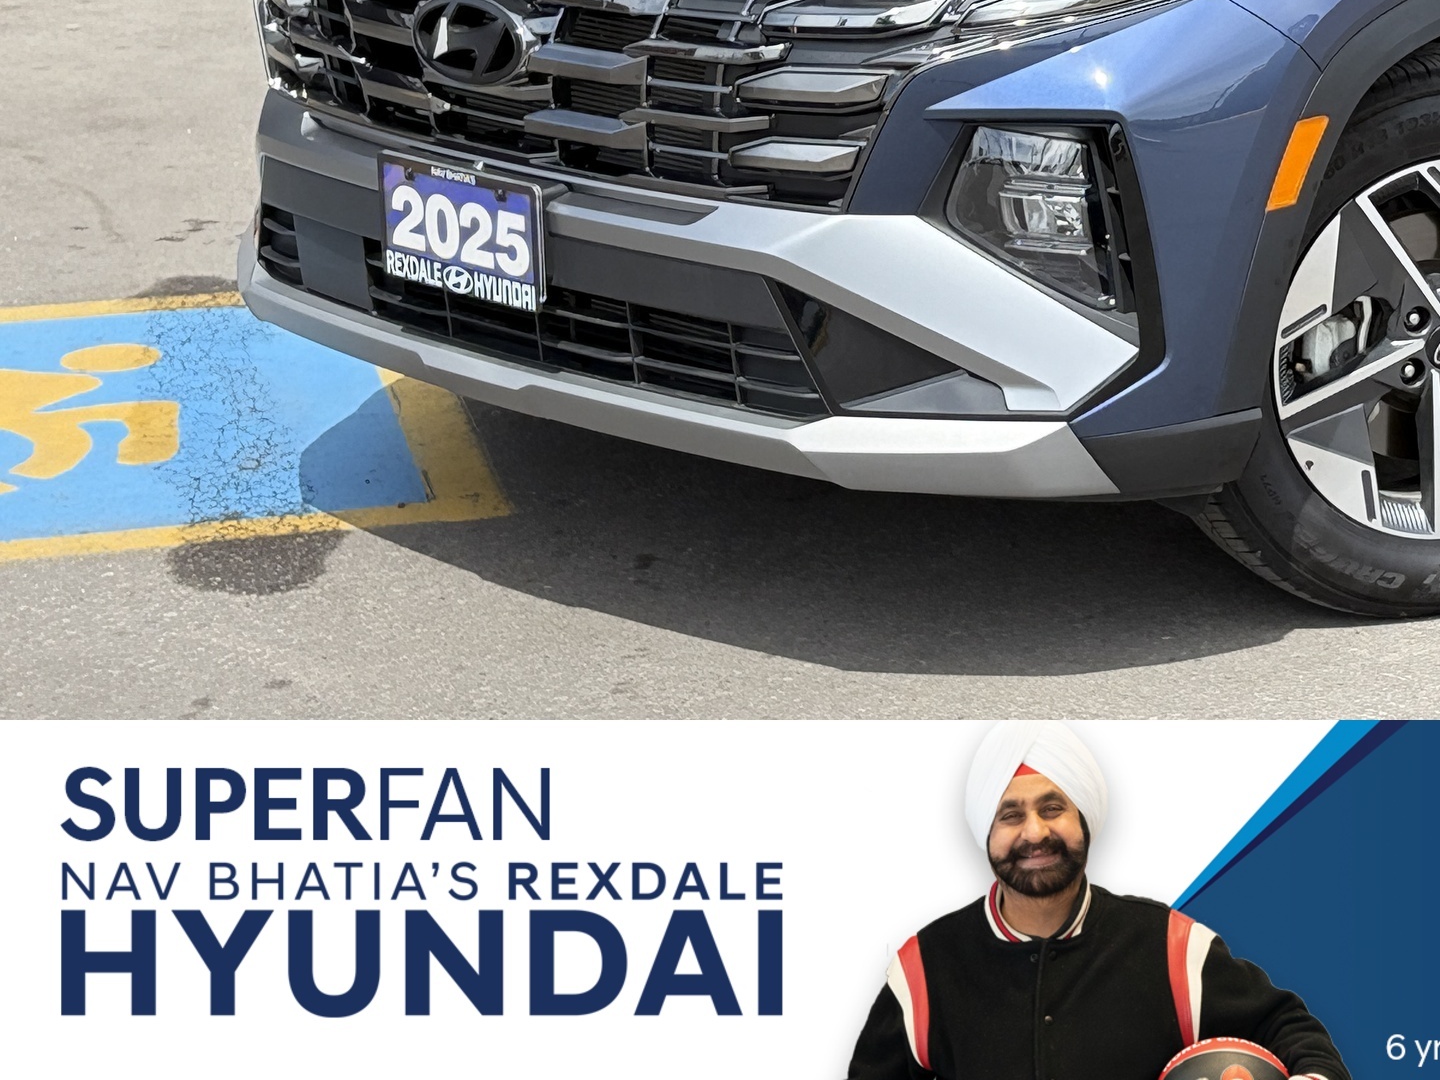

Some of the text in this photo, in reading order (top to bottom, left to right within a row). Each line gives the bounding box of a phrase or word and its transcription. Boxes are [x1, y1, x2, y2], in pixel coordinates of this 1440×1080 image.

[391, 185, 530, 277] 2025
[386, 249, 537, 312] REXDALE HYUNDAI
